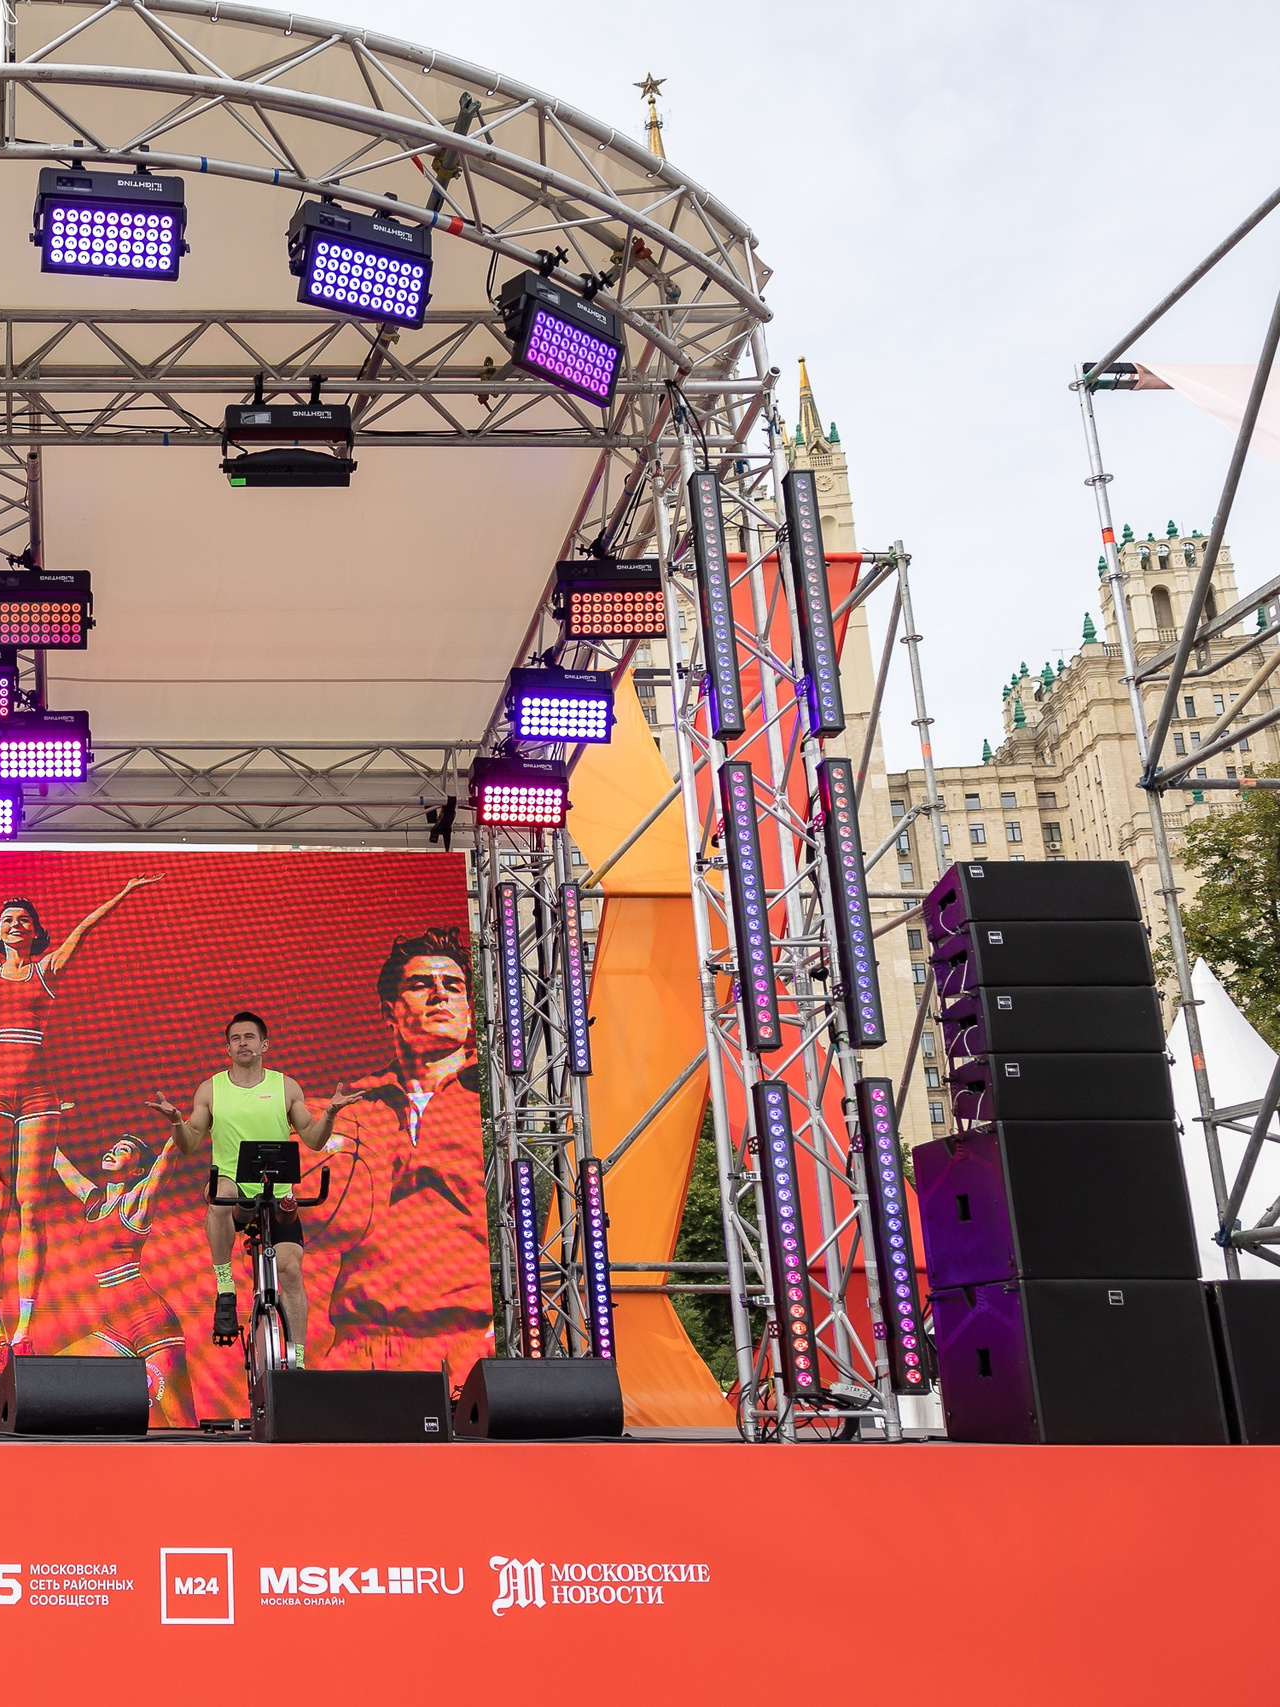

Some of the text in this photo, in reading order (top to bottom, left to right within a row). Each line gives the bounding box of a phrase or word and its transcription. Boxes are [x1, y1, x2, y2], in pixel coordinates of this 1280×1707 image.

[29, 1564, 117, 1576] МОСКОВСКАЯ
[549, 1563, 711, 1582] МОСКОВСКИЕ
[29, 1577, 134, 1591] СЕТЬ РАЙОННЫХ
[29, 1594, 110, 1607] СООБЩЕСТВ
[260, 1596, 346, 1606] МОСКВА ОНЛАЙН
[551, 1585, 665, 1604] НОВОСТИ
